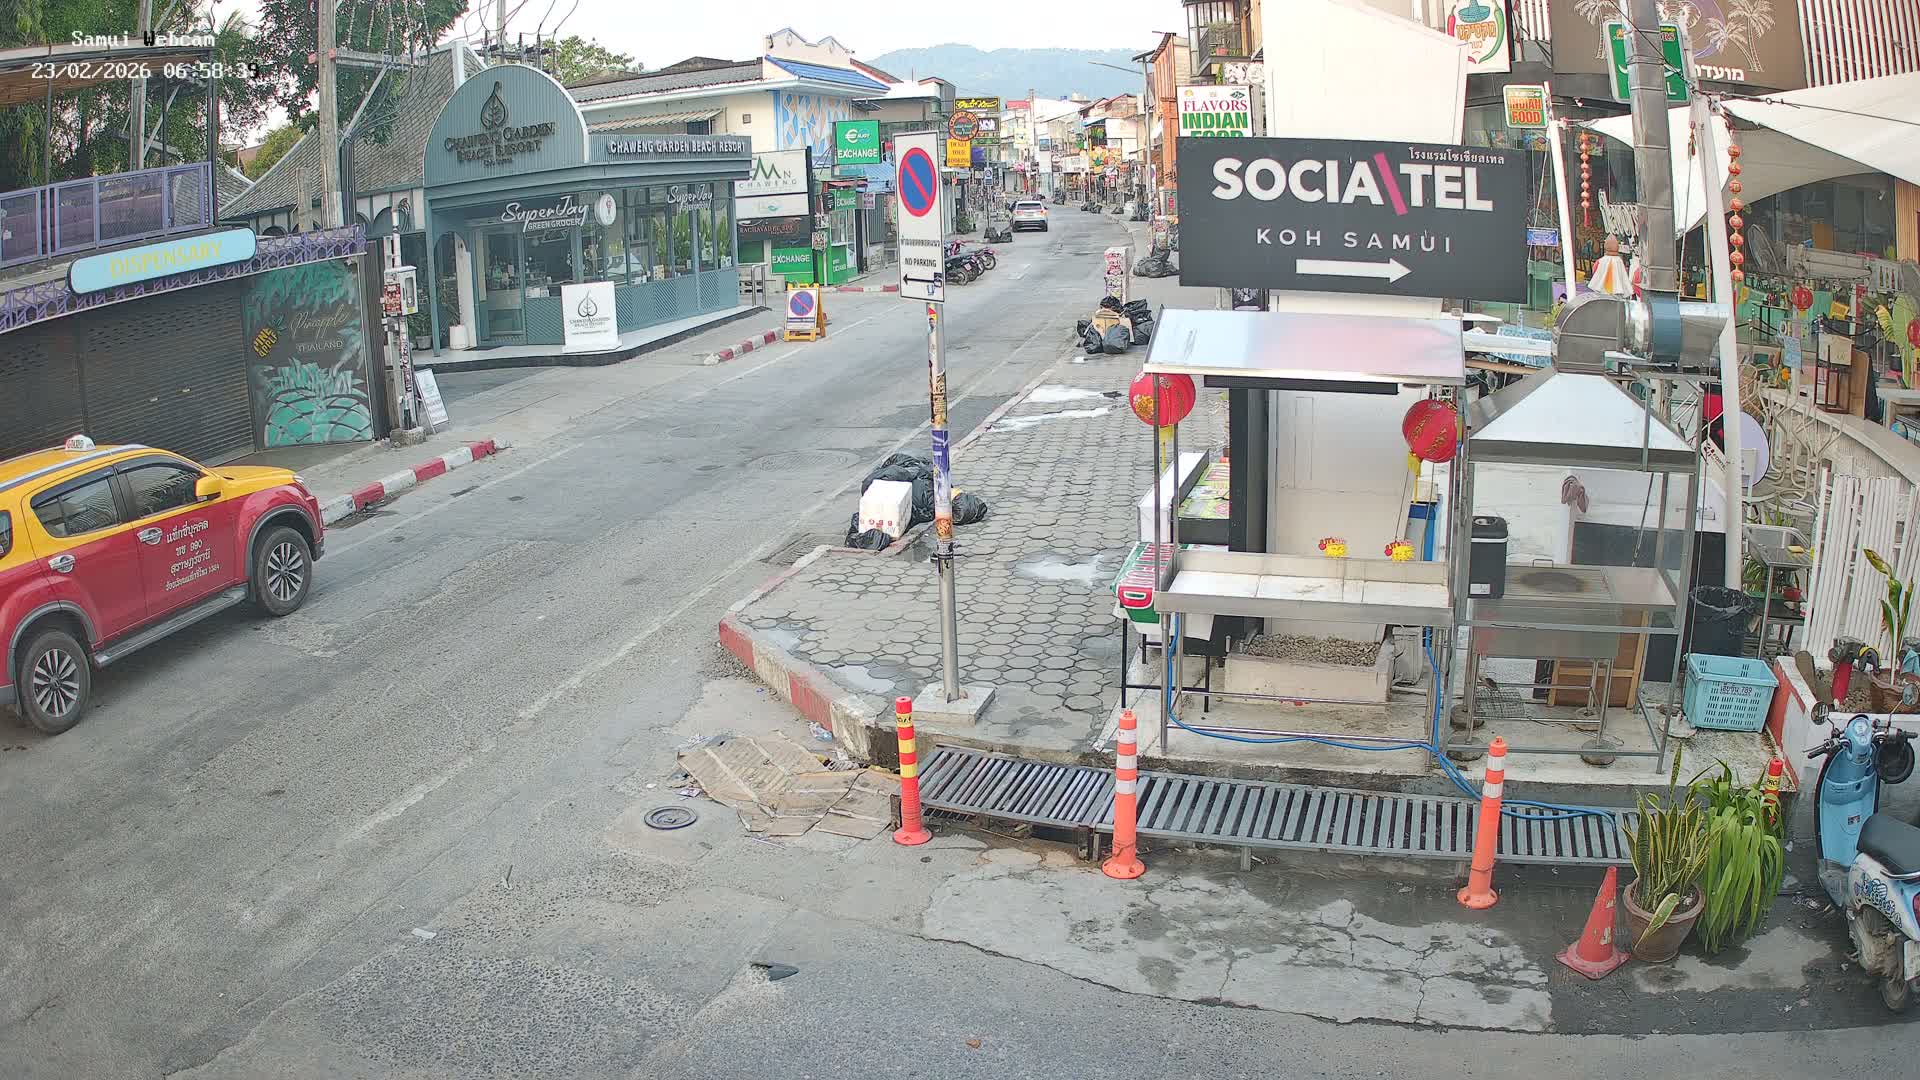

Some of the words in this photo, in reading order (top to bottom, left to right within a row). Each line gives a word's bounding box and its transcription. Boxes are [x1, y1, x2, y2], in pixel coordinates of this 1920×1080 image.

[1184, 100, 1248, 112] FLAVORS
[1510, 96, 1542, 110] INDIAN
[1182, 112, 1248, 129] INDIAN
[1512, 110, 1542, 124] FOOD
[609, 140, 654, 153] CHAWENG
[656, 140, 690, 152] GARDEN
[692, 140, 717, 152] BEACH
[719, 141, 746, 152] RESORT
[838, 149, 878, 159] EXCHANGE
[1256, 228, 1322, 247] KOH
[1343, 230, 1451, 253] SAMUI
[109, 240, 223, 279] DISPENSARY
[772, 254, 811, 263] EXCHANGE
[905, 257, 912, 265] NO
[913, 258, 937, 267] PARKING
[295, 340, 344, 353] THAILAND
